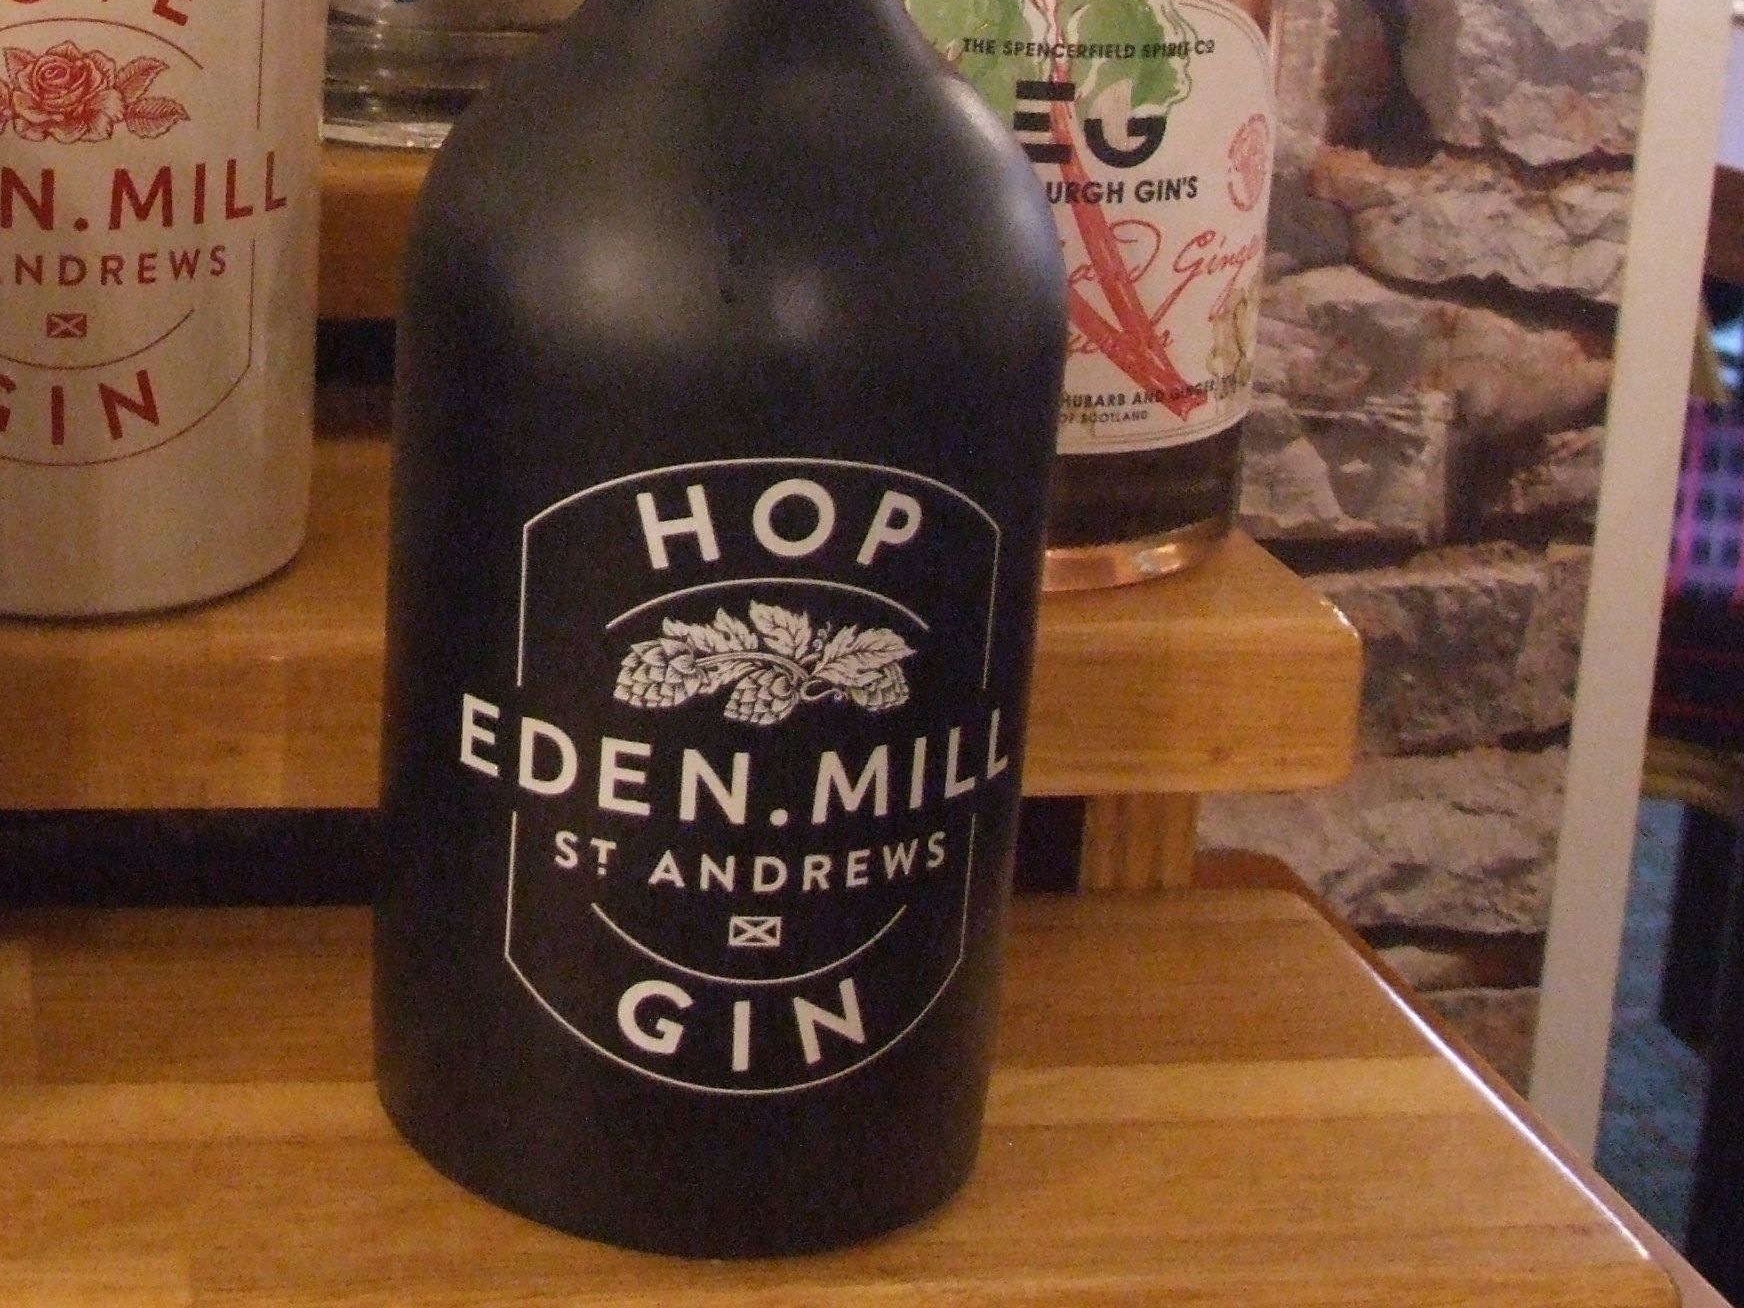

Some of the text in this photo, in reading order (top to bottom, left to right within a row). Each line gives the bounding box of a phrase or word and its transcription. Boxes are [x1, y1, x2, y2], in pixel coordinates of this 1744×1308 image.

[963, 37, 996, 55] THE
[1002, 40, 1136, 60] SPENCERFIELD
[1013, 79, 1168, 169] EG
[1135, 176, 1198, 205] GIN'S
[636, 478, 923, 570] HOP
[648, 831, 947, 893] ANDREWS
[617, 977, 866, 1073] GIN
